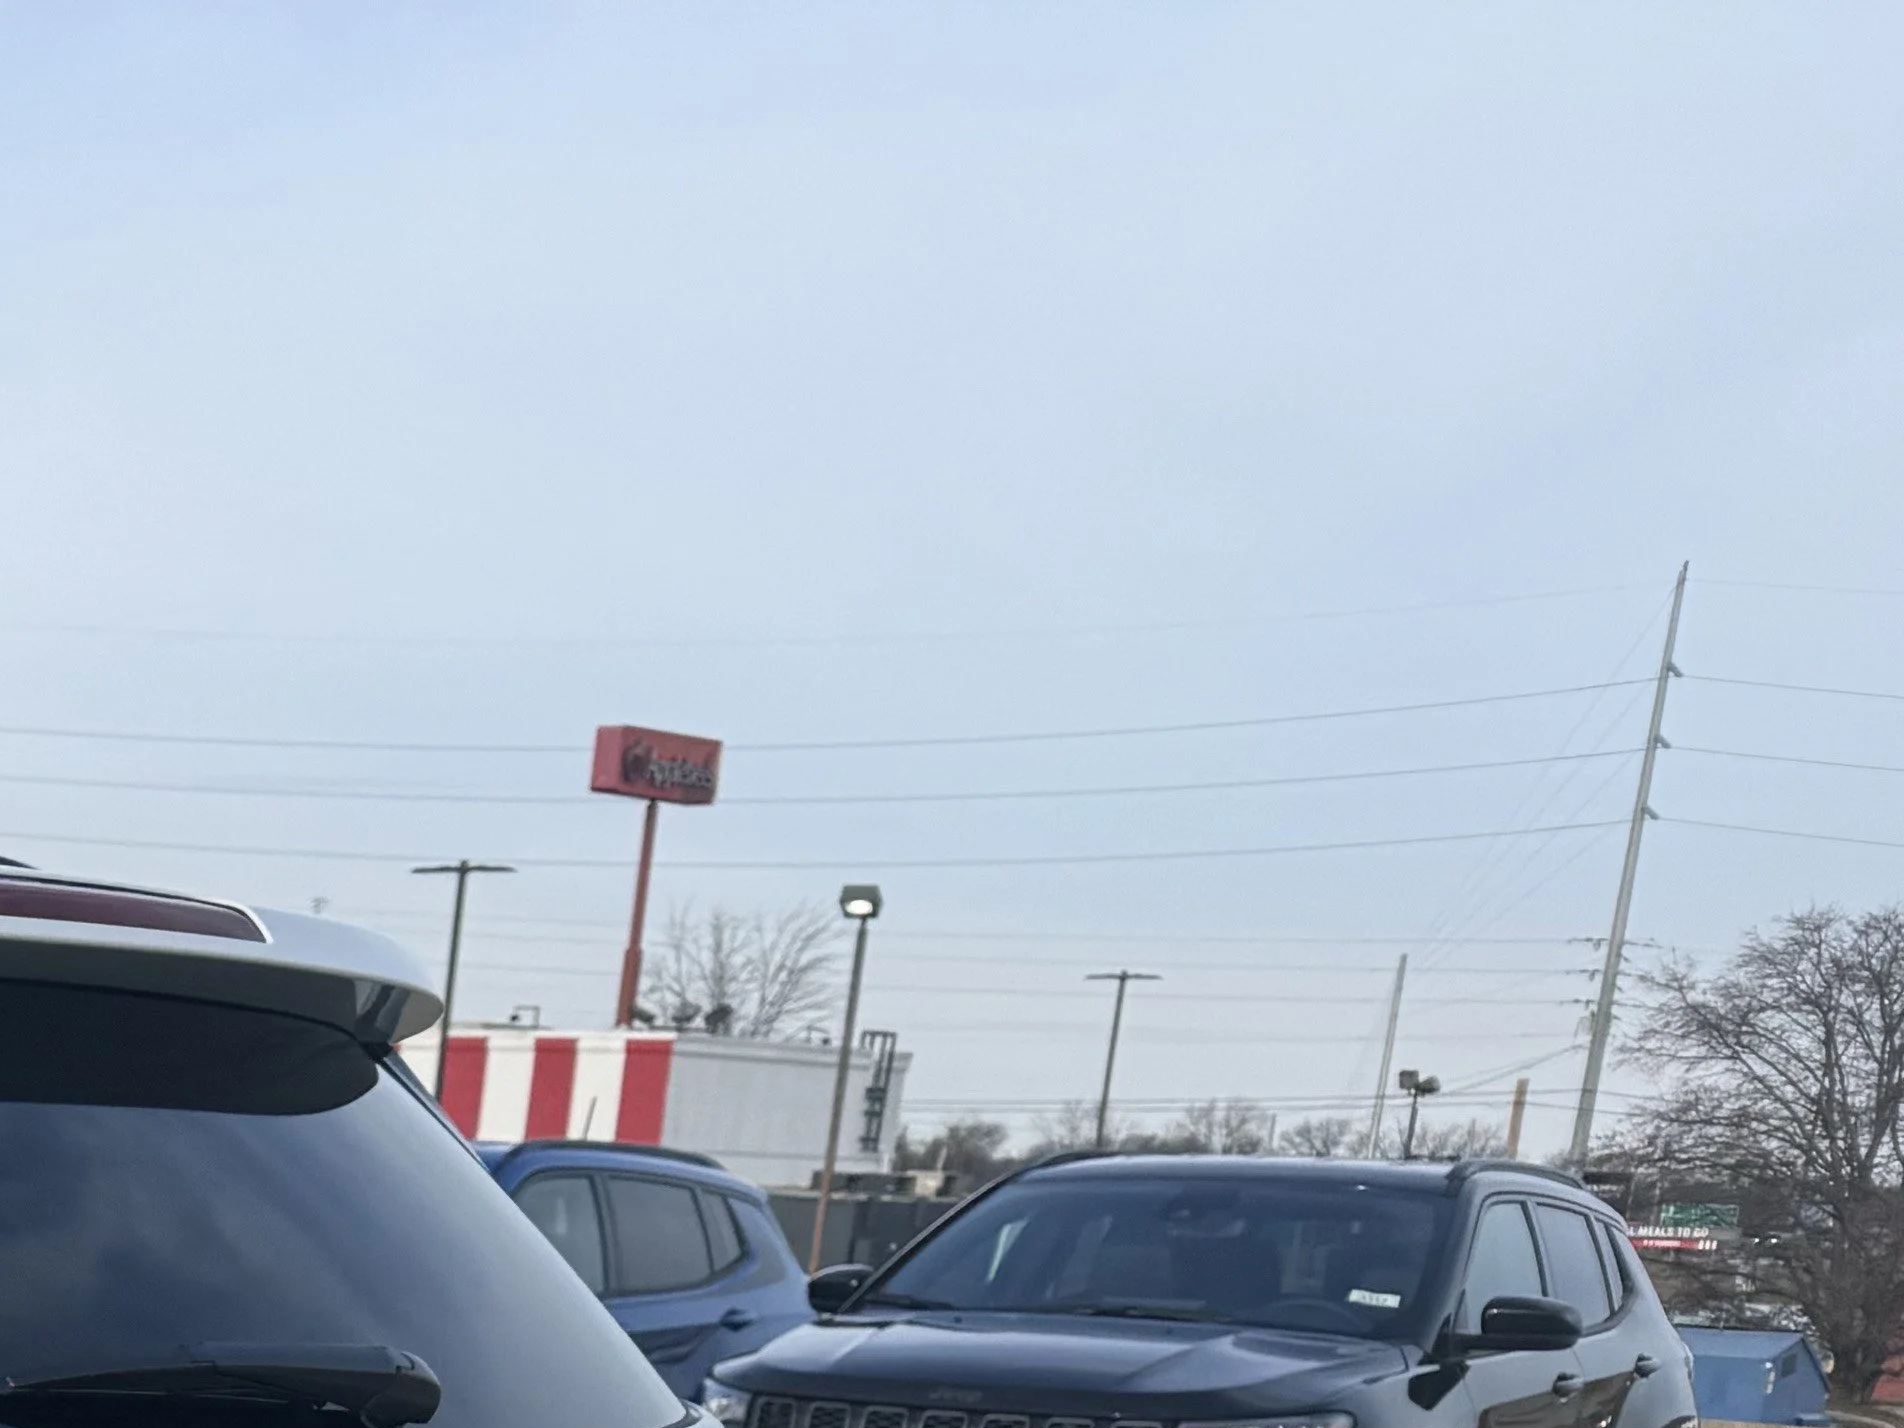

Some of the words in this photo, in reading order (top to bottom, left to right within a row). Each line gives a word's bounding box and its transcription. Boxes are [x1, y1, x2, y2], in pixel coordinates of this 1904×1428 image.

[1638, 1227, 1675, 1238] MEALS
[1677, 1228, 1691, 1238] TO
[1693, 1228, 1710, 1238] GO
